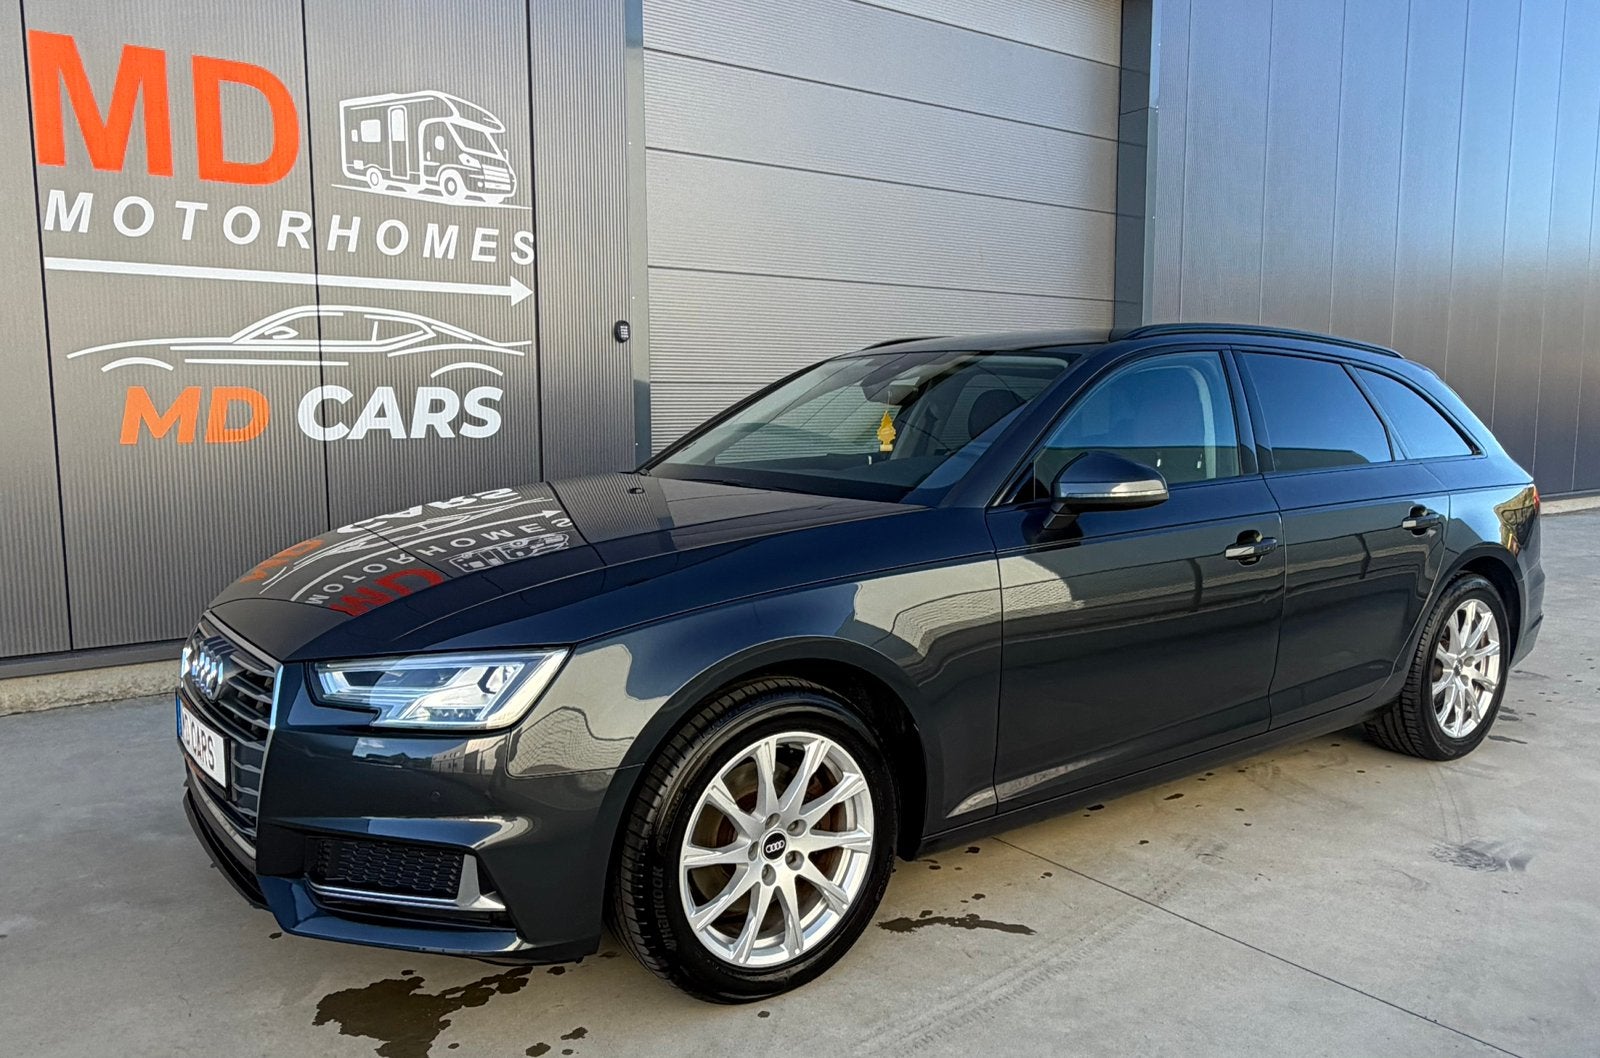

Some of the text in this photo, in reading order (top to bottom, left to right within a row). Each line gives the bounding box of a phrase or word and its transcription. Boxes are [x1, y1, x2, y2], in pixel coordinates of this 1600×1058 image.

[28, 29, 299, 186] MD
[44, 189, 534, 266] MOTORHOMES
[120, 385, 503, 444] MD CARS
